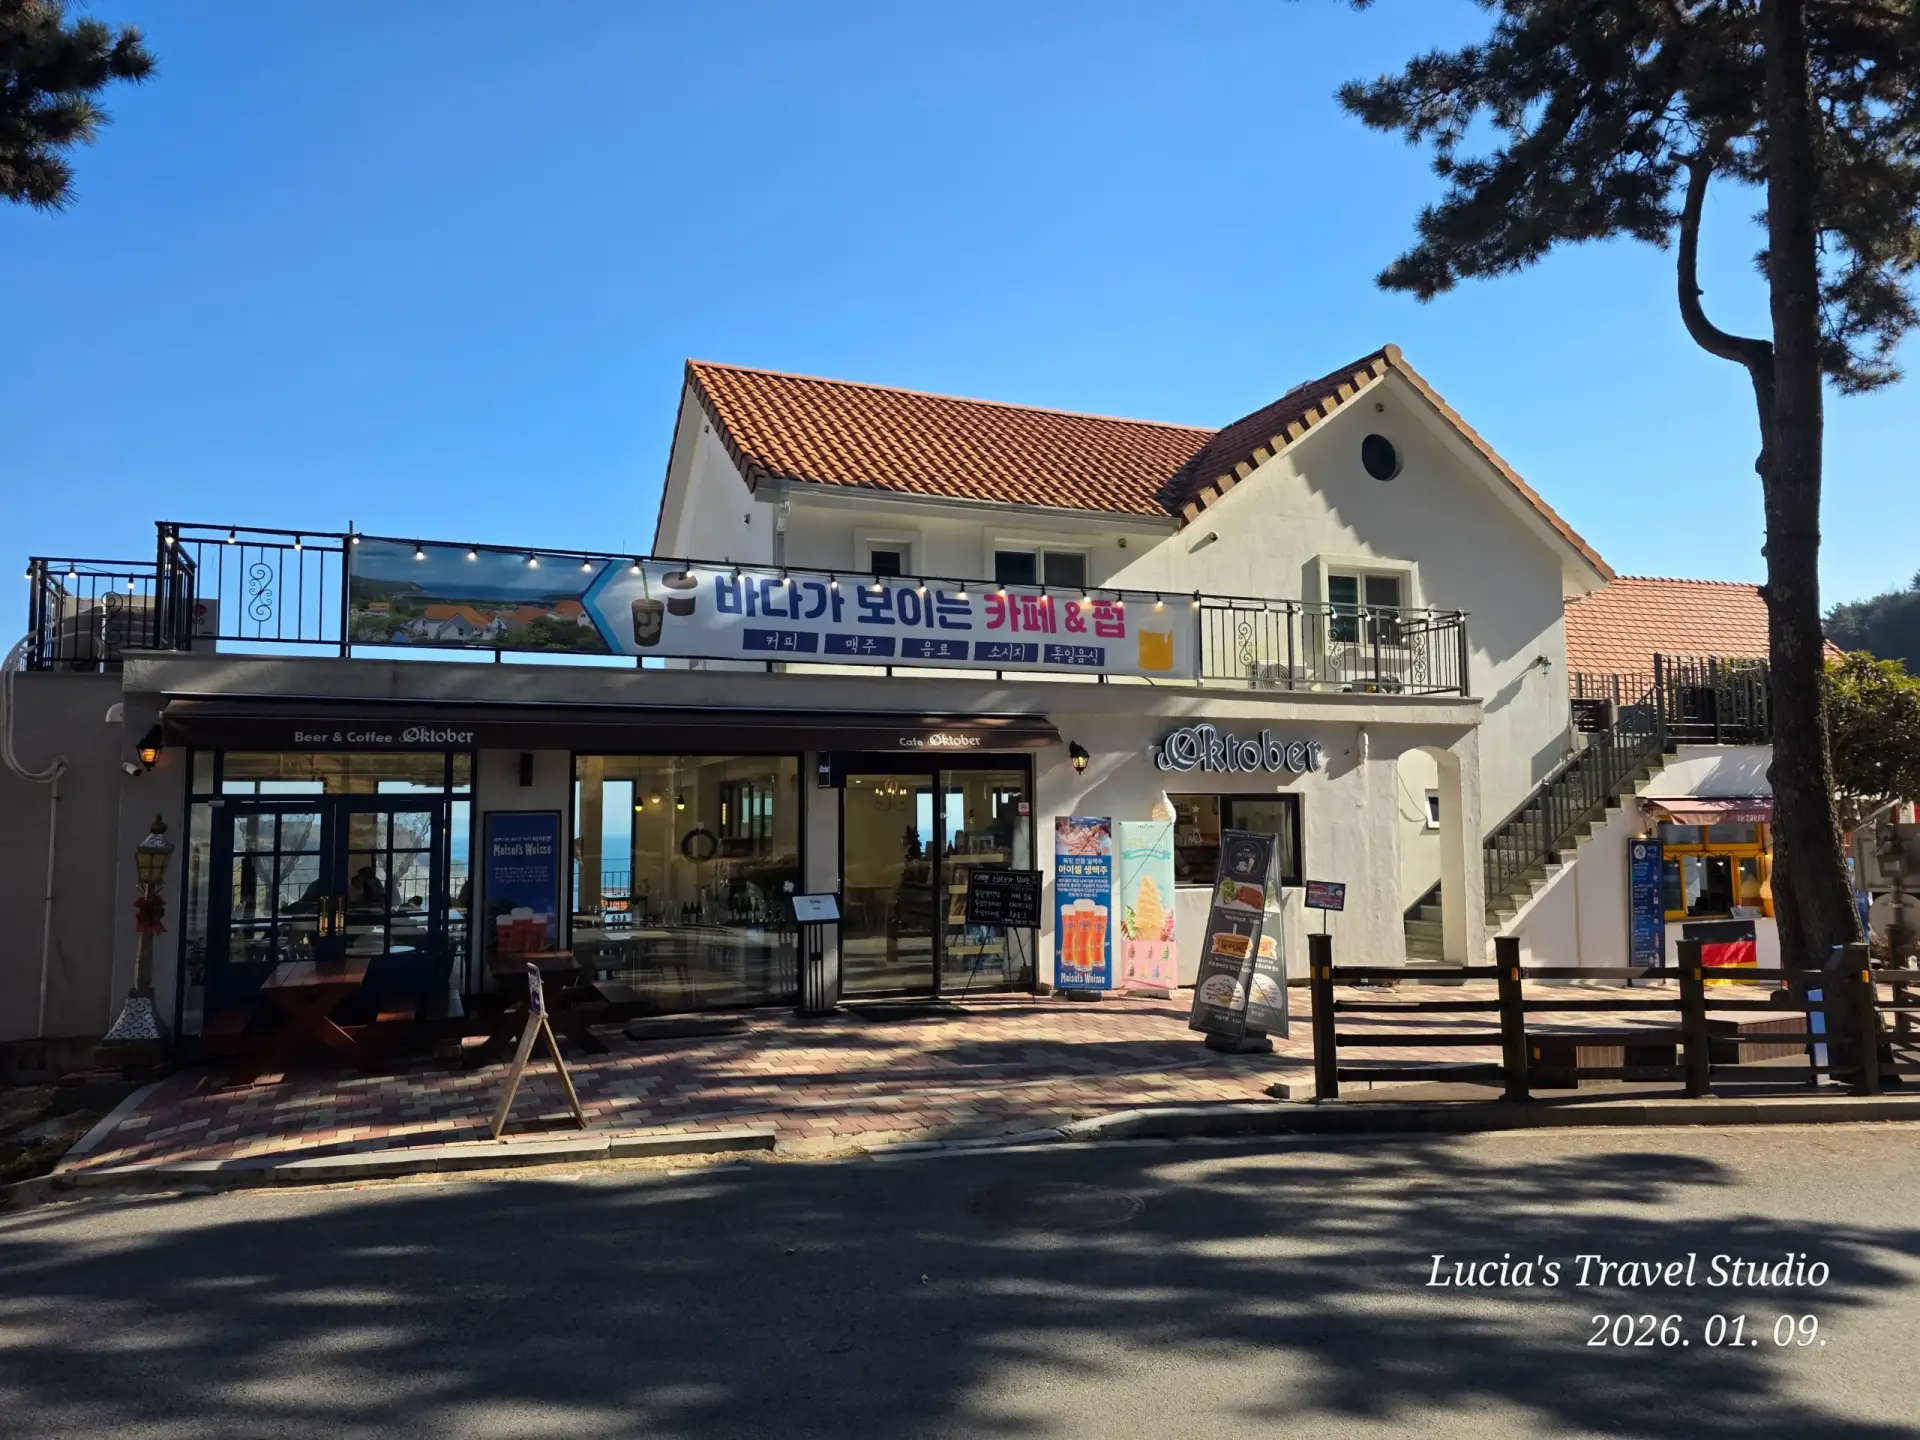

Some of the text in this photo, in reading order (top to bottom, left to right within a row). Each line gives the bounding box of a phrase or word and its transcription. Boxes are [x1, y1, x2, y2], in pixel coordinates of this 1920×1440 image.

[714, 575, 1126, 639] 바다가 보이는 카페 & 펍
[765, 631, 798, 650] 커피
[845, 636, 877, 654] 맥주
[920, 641, 951, 657] 음료
[988, 643, 1026, 661] 소시지
[1051, 646, 1098, 664] 독일음식
[294, 726, 474, 743] Beer & Coffee Oktober
[899, 733, 981, 746] Cafe Oktober
[1157, 723, 1324, 773] Oktober
[525, 843, 552, 856] Weisse
[1058, 865, 1108, 875] 마이셀 생맥주
[1060, 972, 1106, 984] Maisel's Weisse
